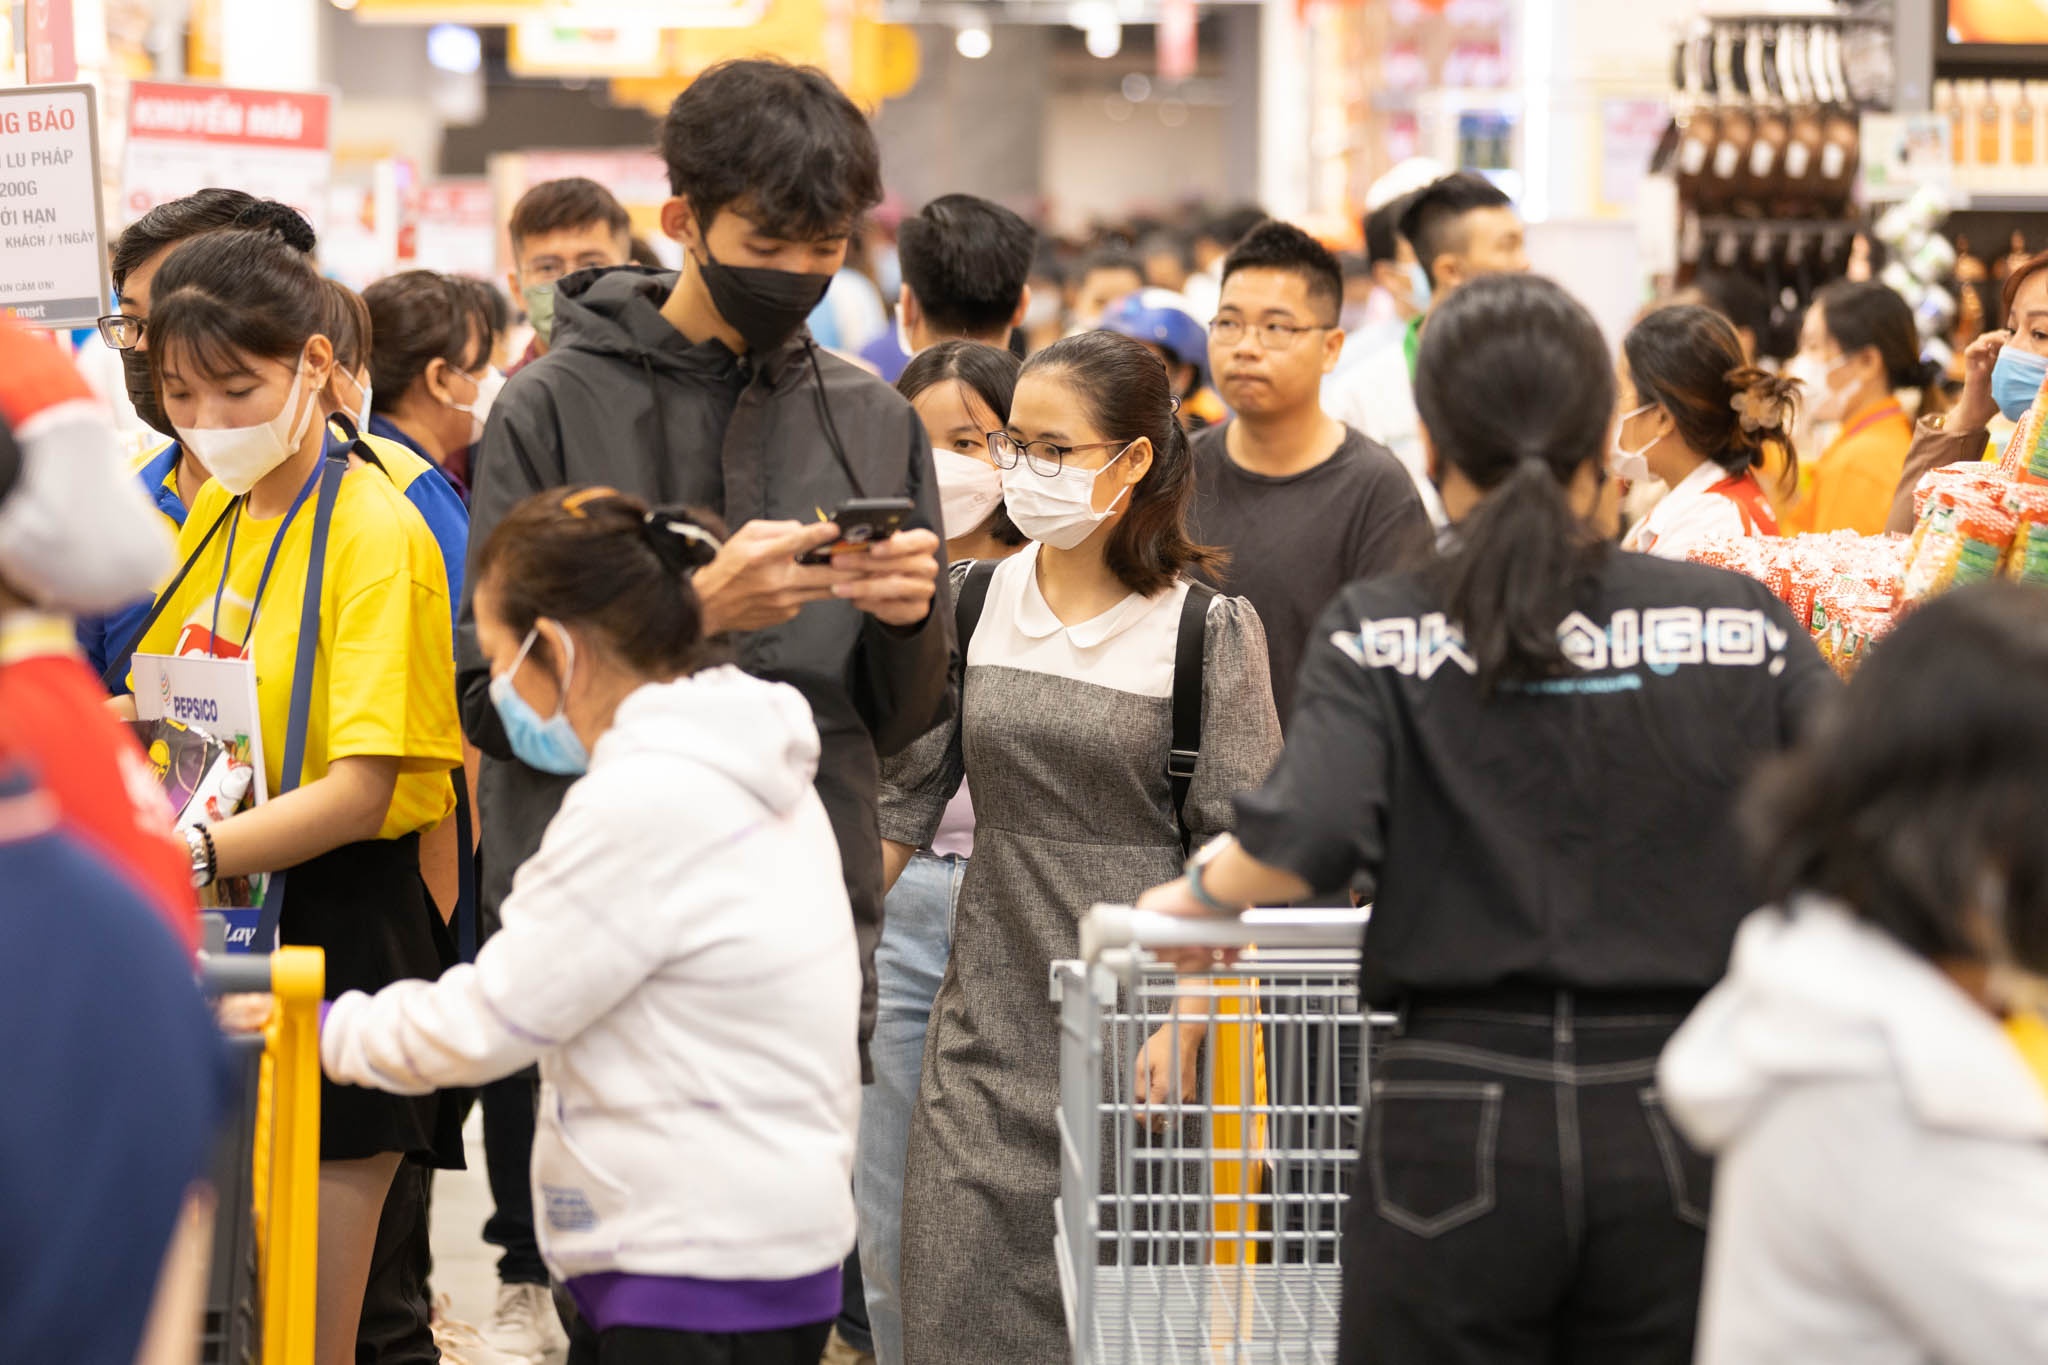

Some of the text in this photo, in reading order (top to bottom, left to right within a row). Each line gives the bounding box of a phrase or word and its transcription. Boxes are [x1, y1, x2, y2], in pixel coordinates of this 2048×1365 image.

[28, 104, 75, 132] BÁO
[6, 147, 73, 169] LU PHÁP
[22, 208, 56, 229] HẠN
[173, 696, 218, 722] PEPSICO
